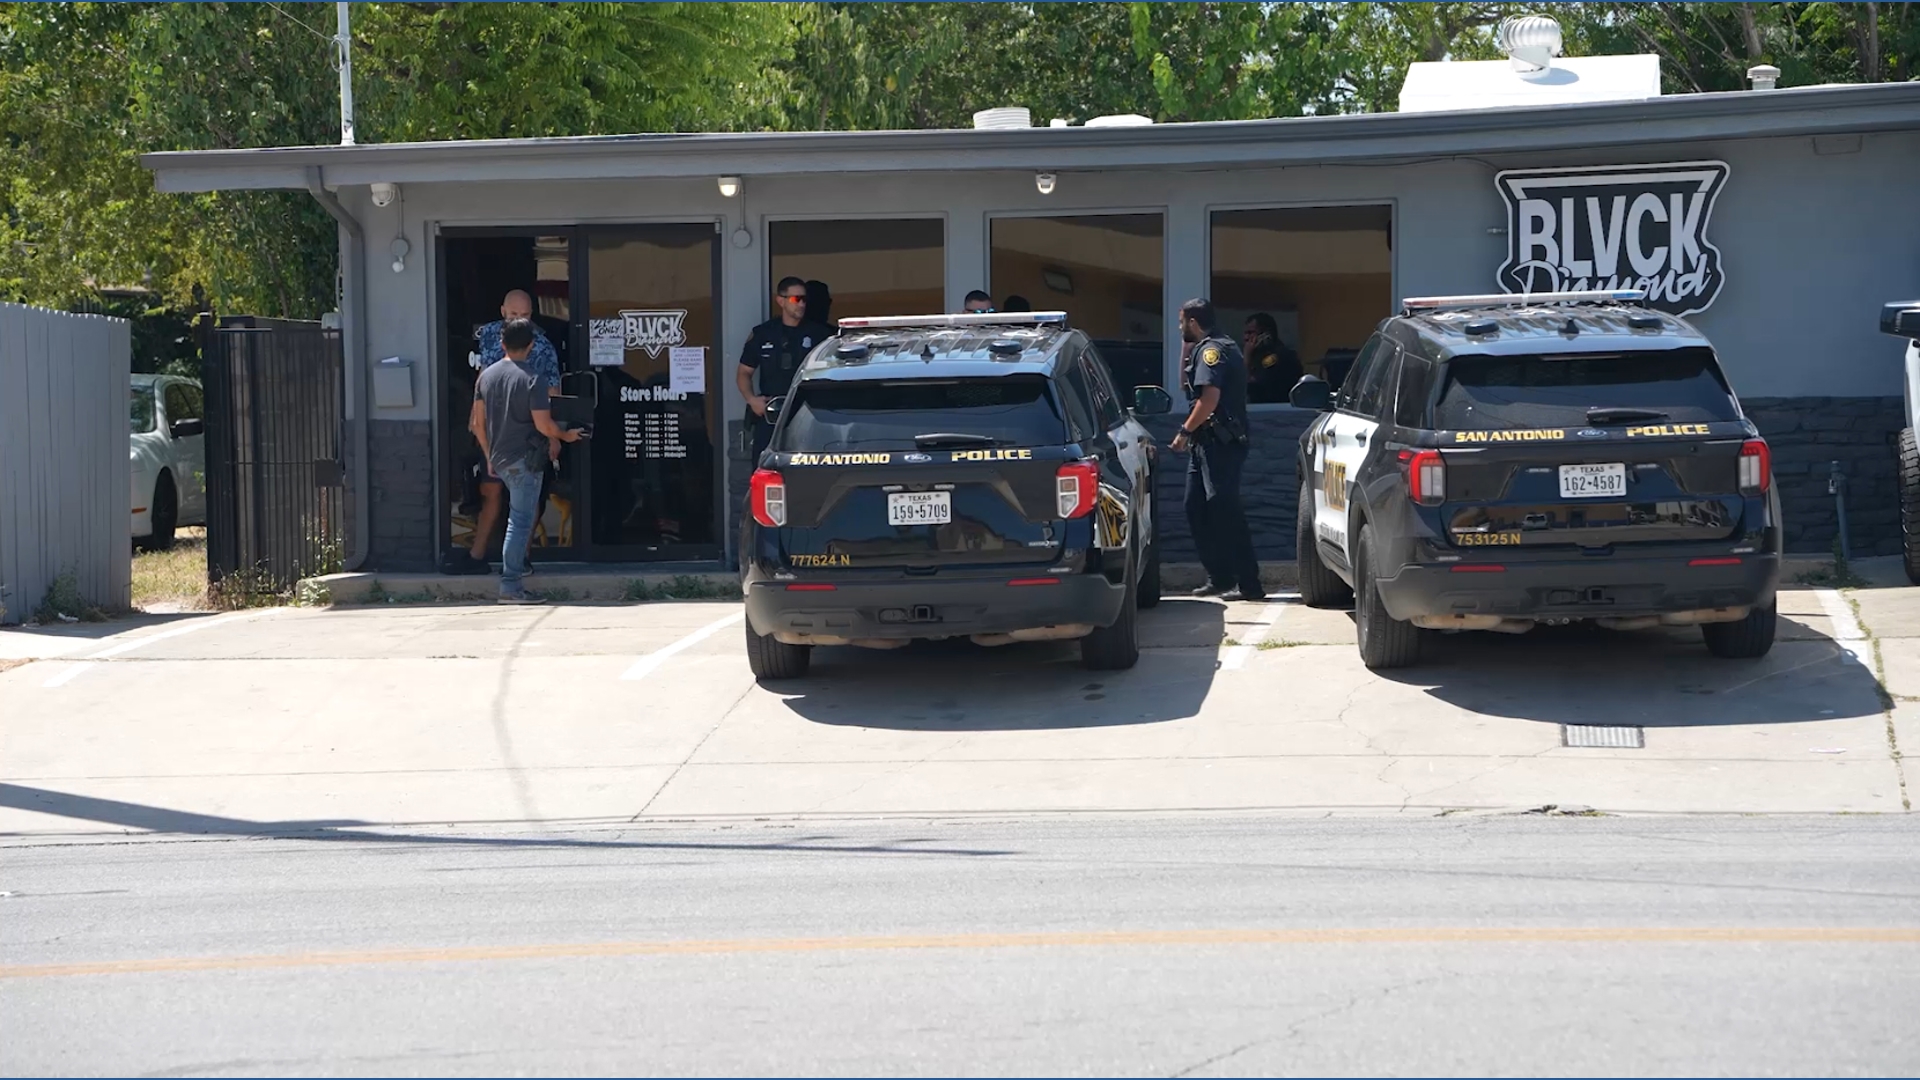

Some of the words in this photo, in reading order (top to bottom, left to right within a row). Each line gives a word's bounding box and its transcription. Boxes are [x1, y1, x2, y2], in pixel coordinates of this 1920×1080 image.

[1519, 192, 1707, 279] BLVCK
[598, 325, 621, 335] ONLY
[626, 317, 681, 338] BLVCK
[620, 386, 651, 402] Store
[653, 386, 687, 401] Hours
[1455, 431, 1487, 442] SAN
[1489, 430, 1565, 442] ANTONIO
[1626, 424, 1711, 437] POLICE
[790, 453, 819, 466] SAN
[820, 454, 890, 466] ANTONIO
[952, 449, 1032, 462] POLICE
[1456, 534, 1508, 545] 753125
[1511, 533, 1520, 544] N
[790, 555, 836, 566] 777624
[841, 555, 850, 566] N
